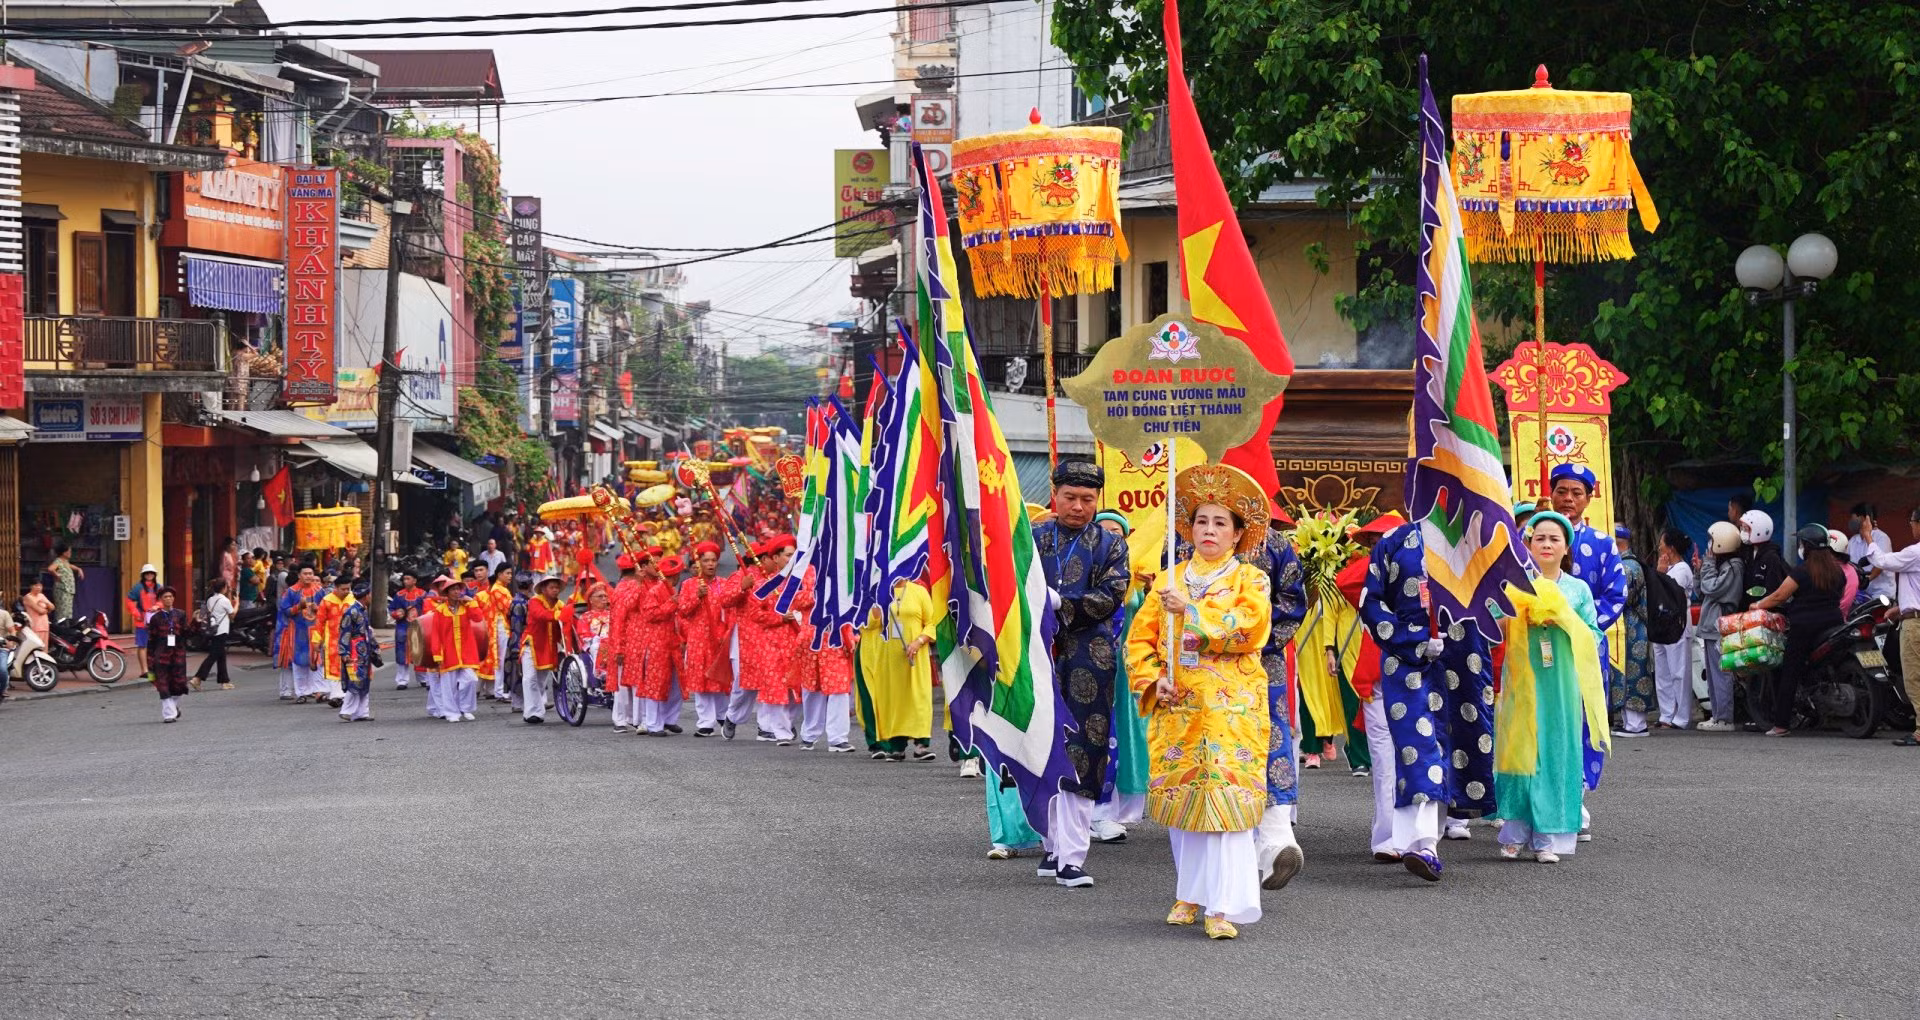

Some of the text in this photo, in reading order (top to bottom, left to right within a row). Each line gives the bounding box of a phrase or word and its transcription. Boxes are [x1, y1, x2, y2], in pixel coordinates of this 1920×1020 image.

[513, 218, 538, 230] CUNG
[516, 231, 536, 246] CẤP
[294, 201, 329, 325] KHÁNH
[294, 331, 327, 379] TÝ
[1112, 365, 1236, 384] ĐOÀN RƯỚC
[1103, 390, 1128, 402] TAM
[1133, 389, 1167, 401] CUNG
[1170, 387, 1213, 400] VƯƠNG
[90, 401, 100, 425] SỐ
[101, 406, 106, 425] 3
[1107, 403, 1128, 419] HỘI
[1171, 402, 1196, 418] LIỆT
[1143, 419, 1201, 433] CHƯ TIÊN
[1118, 481, 1166, 513] QUỐ
